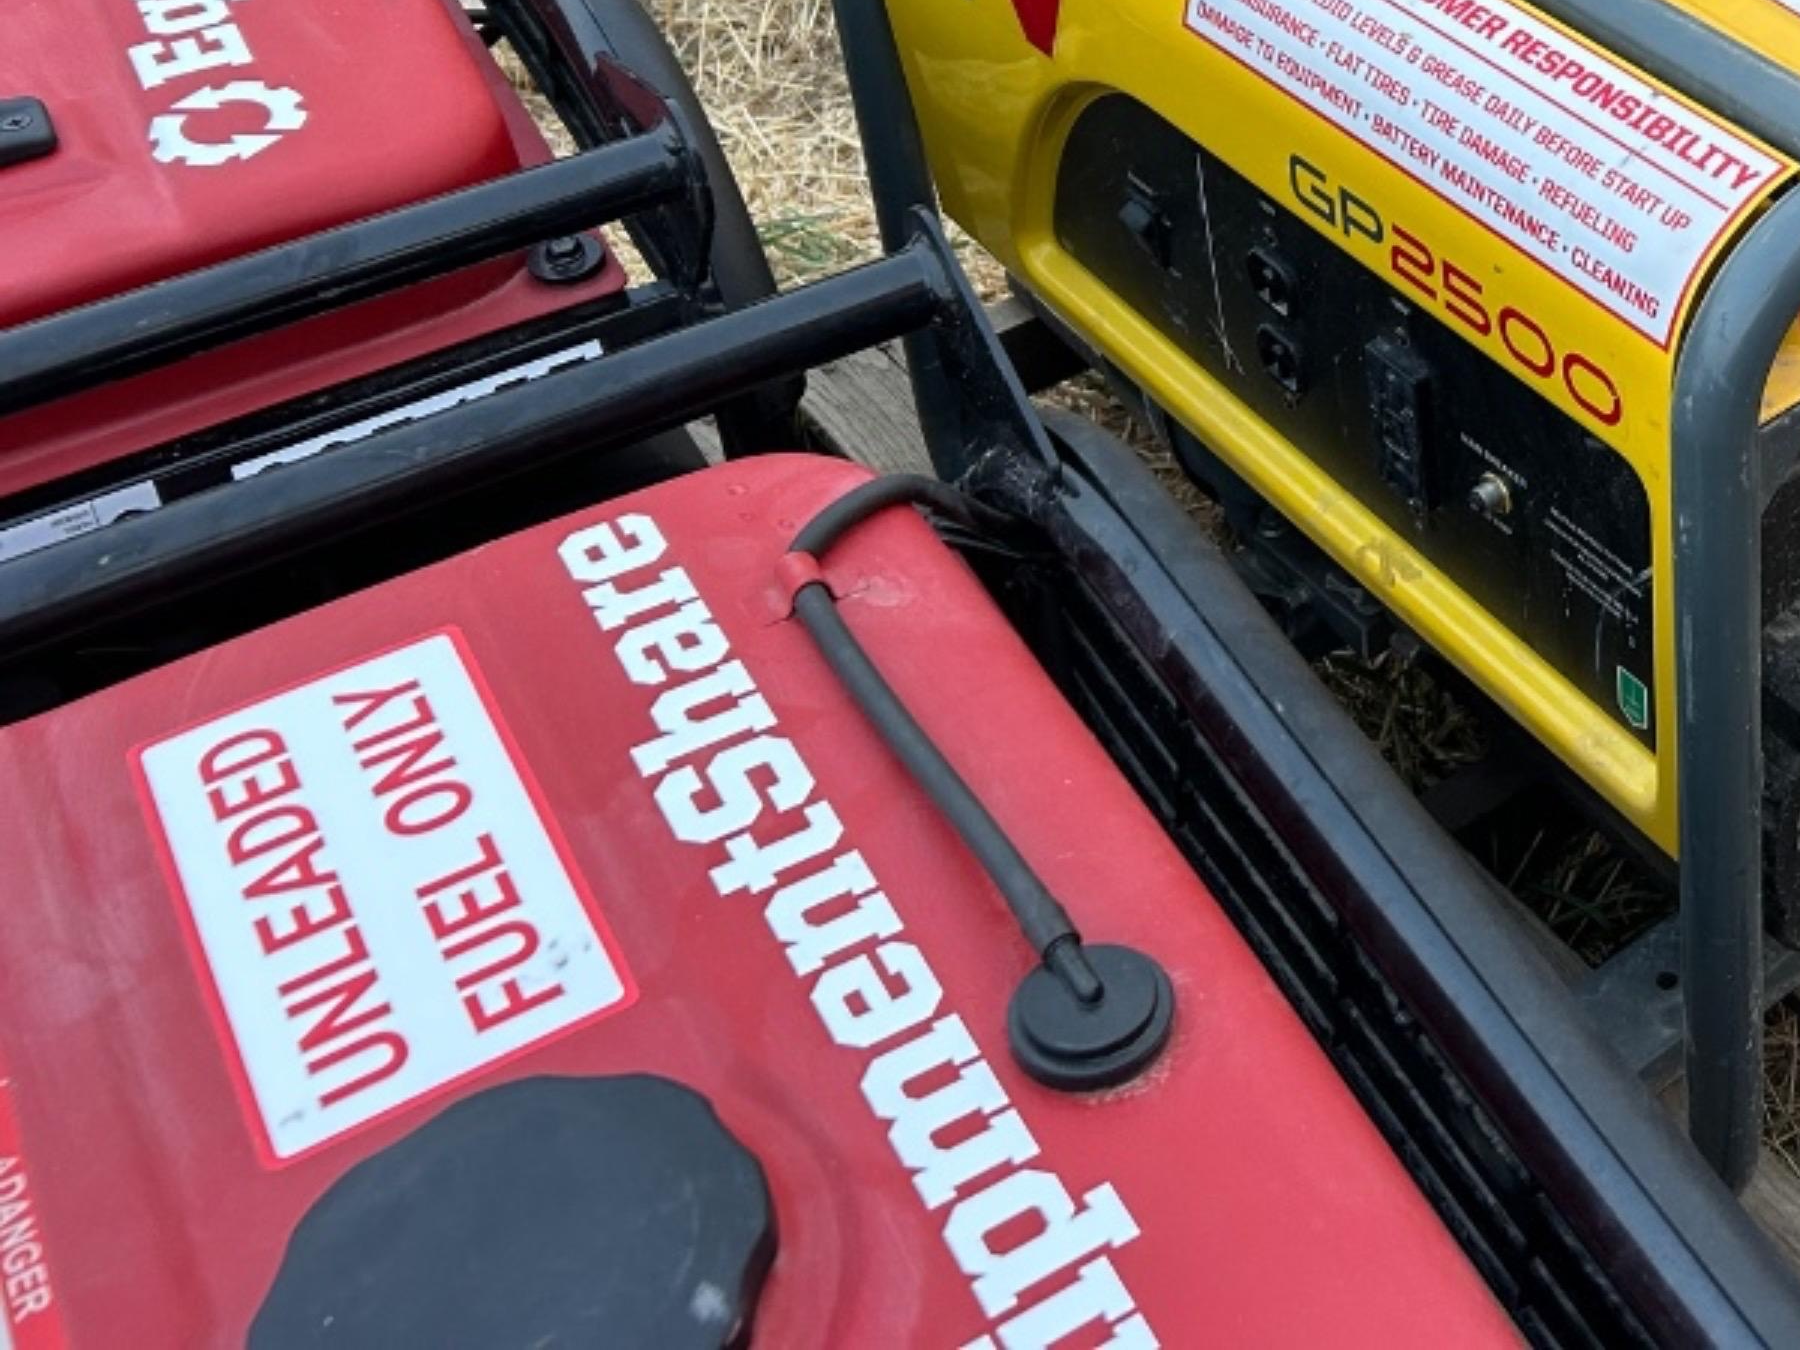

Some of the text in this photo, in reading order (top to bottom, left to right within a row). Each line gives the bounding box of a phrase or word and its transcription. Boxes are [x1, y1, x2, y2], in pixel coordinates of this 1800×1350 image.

[1196, 0, 1660, 319] DAMAGE TO EQUIPMENT BATTERY MAINTENANCE CLEANING
[1326, 41, 1366, 76] FLAT
[1364, 63, 1411, 106] TIRES
[1421, 99, 1460, 137] TIRE
[1458, 126, 1531, 184] DAMAGE
[1538, 177, 1638, 253] REFUELING
[1350, 11, 1408, 55] LEVELS
[1421, 54, 1486, 105] GREASE
[1483, 94, 1539, 135] DAILY
[1533, 125, 1605, 179] BEFORE
[1602, 168, 1662, 215] START
[1659, 205, 1693, 231] UP
[1500, 29, 1761, 190] RESPONSIBILITY
[1289, 153, 1622, 427] GP2500
[198, 728, 409, 1109] UNLEADED
[331, 678, 565, 1035] FUEL ONLY
[0, 1172, 53, 1325] DANGER
